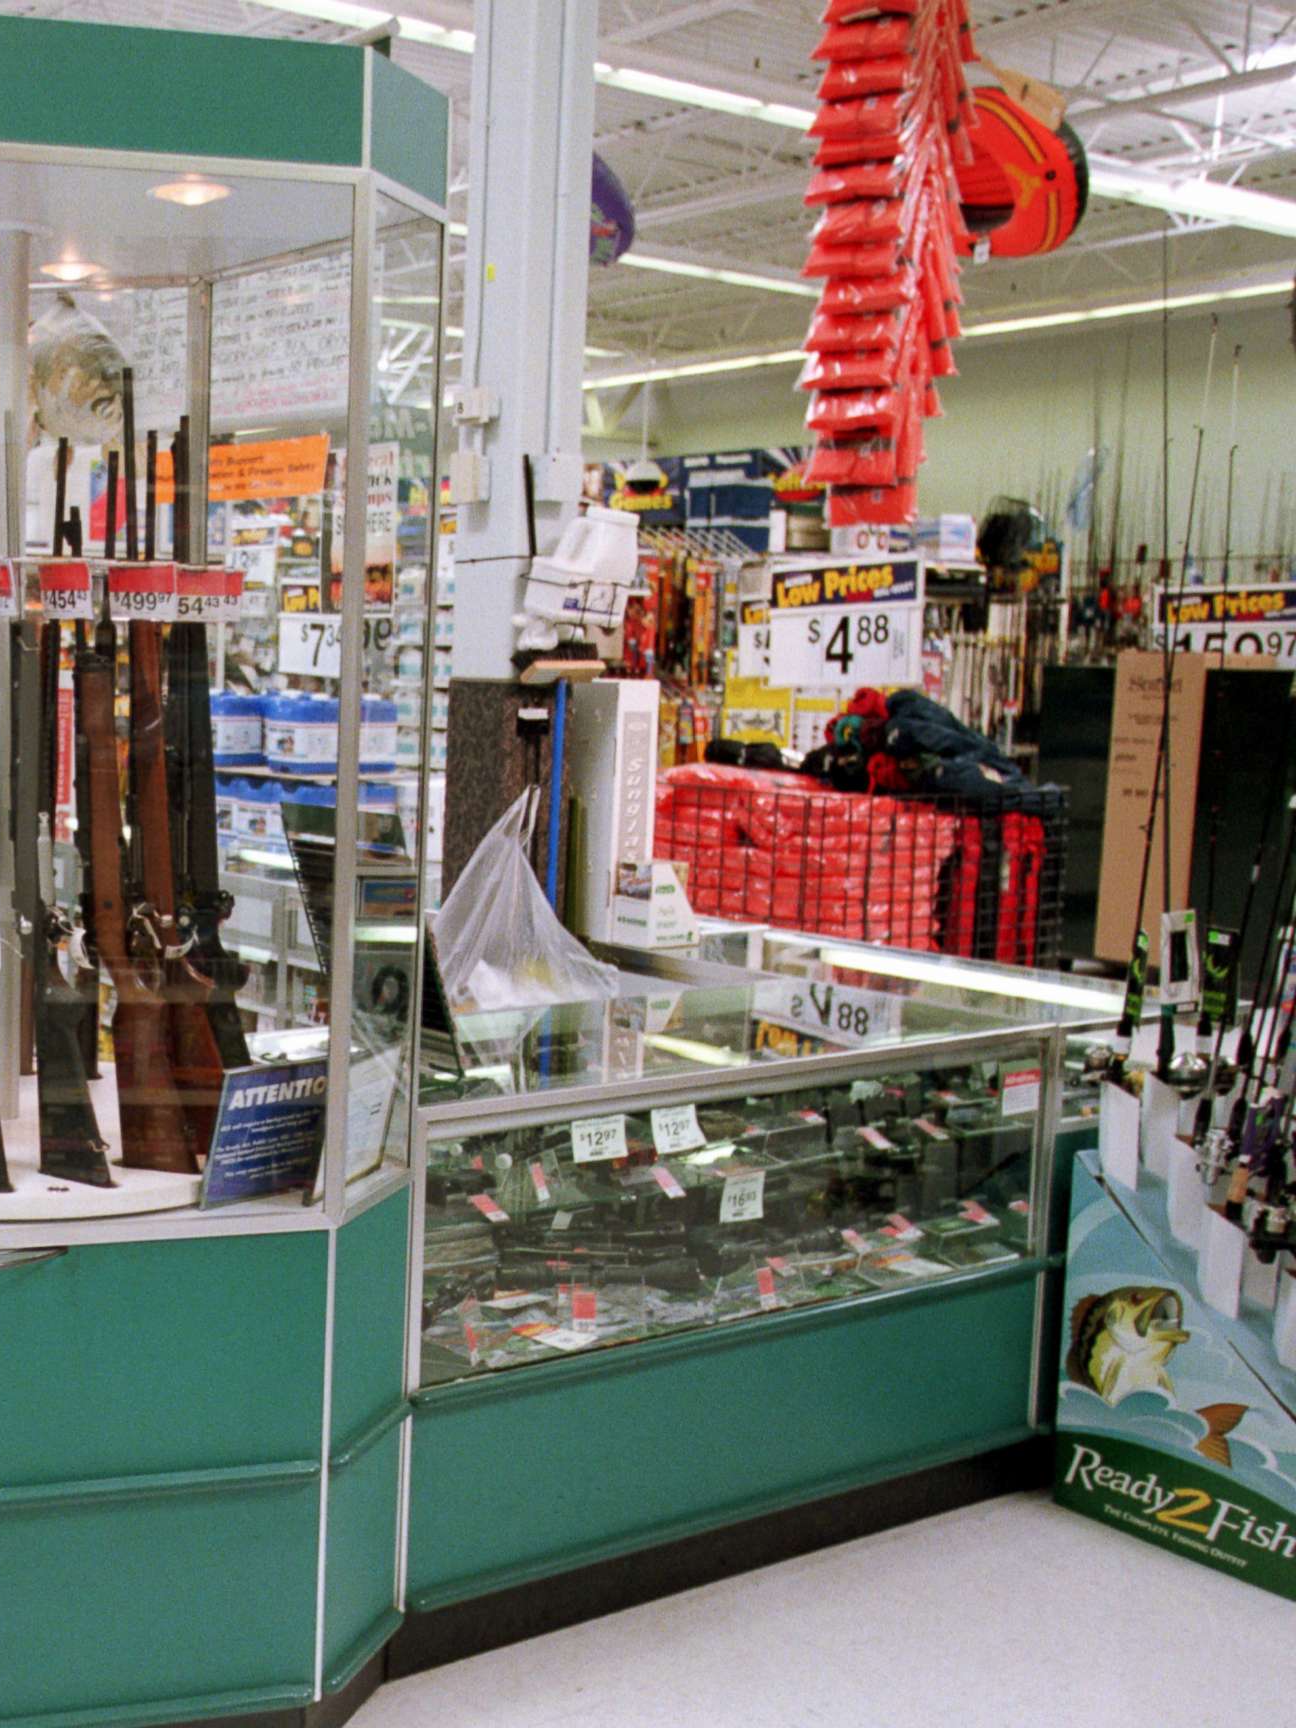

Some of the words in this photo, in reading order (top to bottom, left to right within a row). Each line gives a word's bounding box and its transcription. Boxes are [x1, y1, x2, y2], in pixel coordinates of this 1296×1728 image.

[776, 580, 821, 608] Low
[823, 564, 894, 599] Prices
[1167, 602, 1210, 624] Low
[1212, 591, 1285, 619] Prices
[227, 1075, 329, 1112] ATTENTIO
